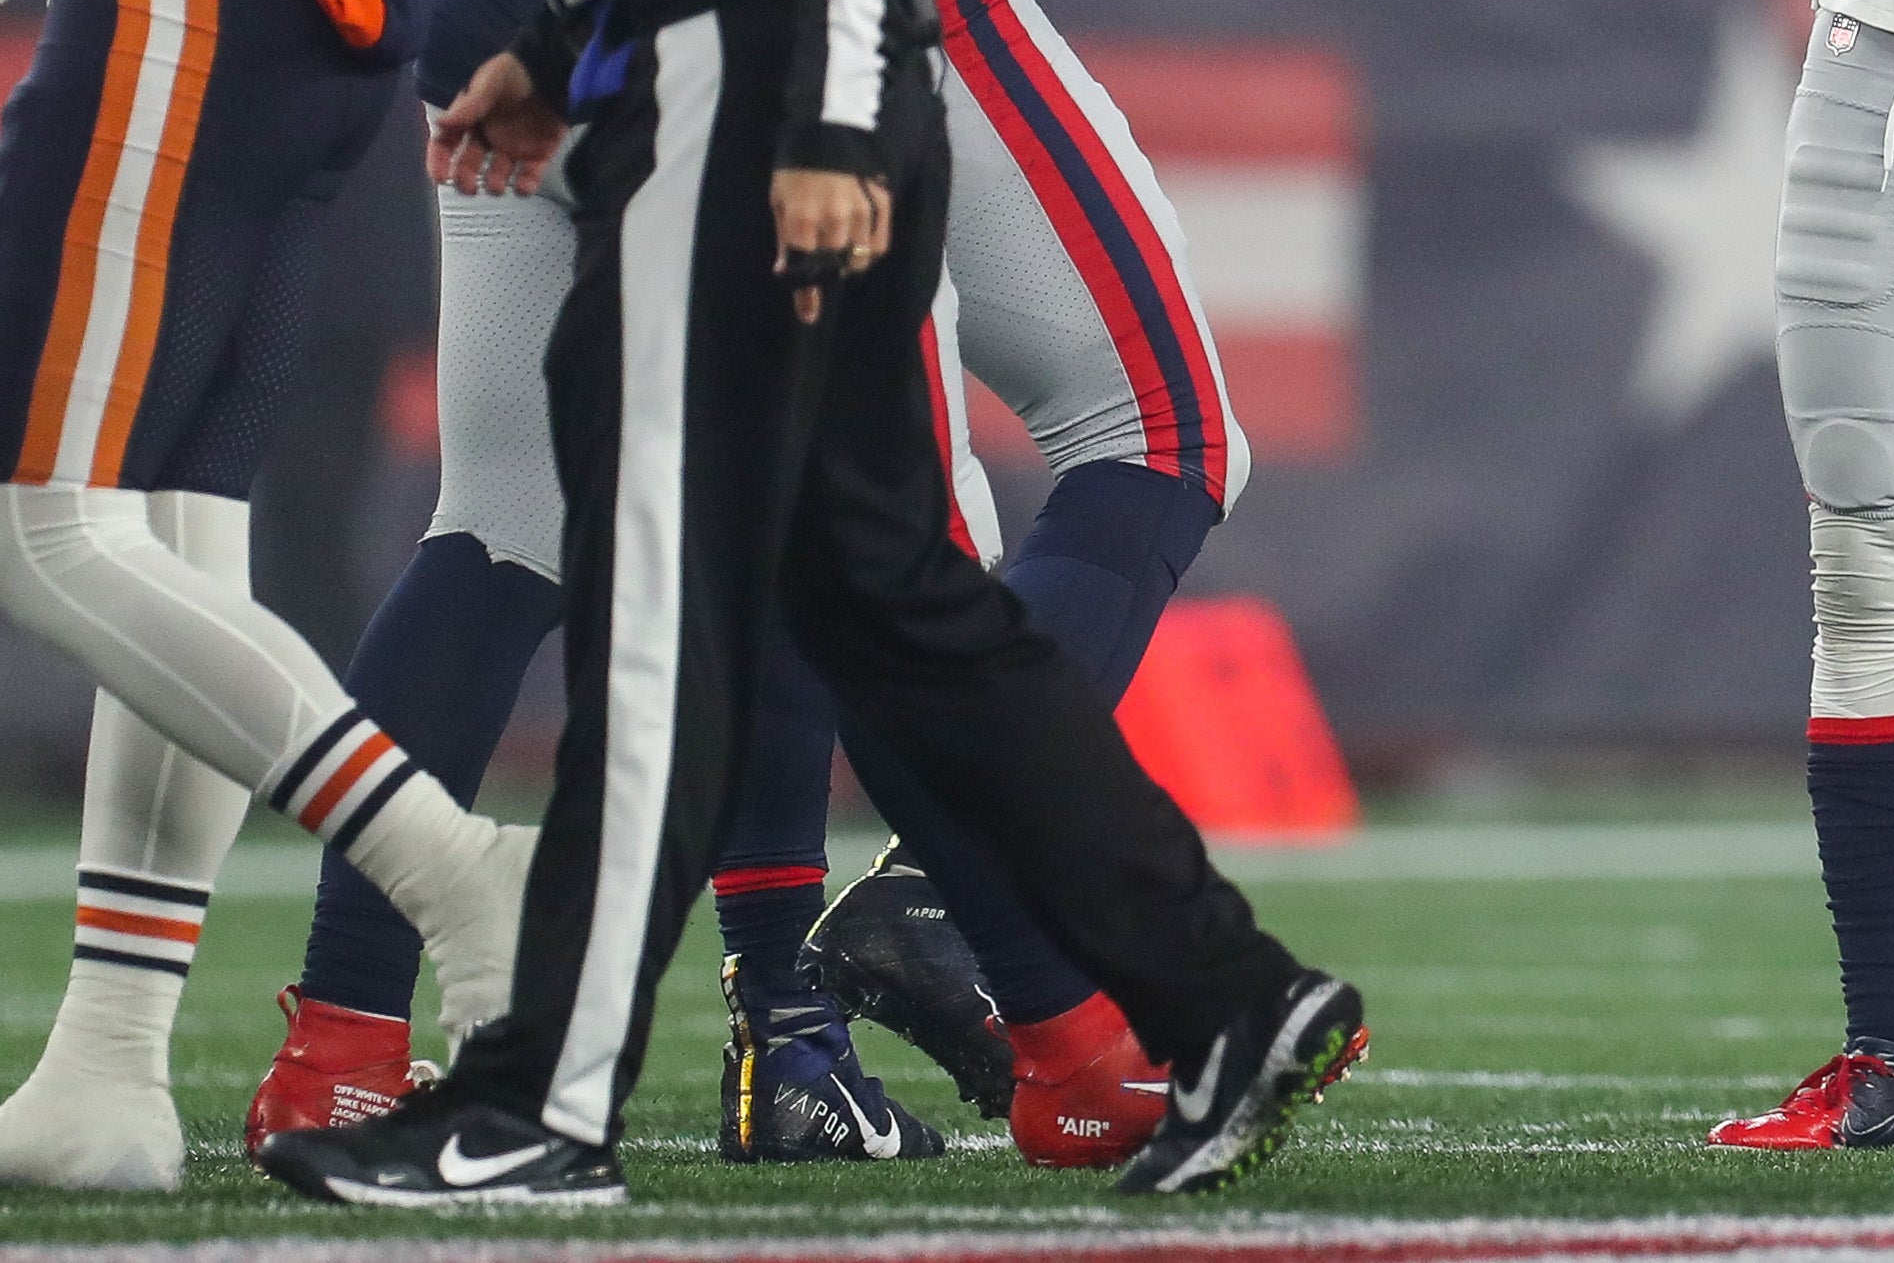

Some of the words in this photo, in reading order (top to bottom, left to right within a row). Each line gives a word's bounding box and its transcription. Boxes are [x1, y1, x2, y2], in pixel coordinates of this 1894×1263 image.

[905, 906, 946, 920] VAPOR
[773, 1082, 850, 1148] VAPOR
[1056, 1115, 1110, 1138] "AIR"
